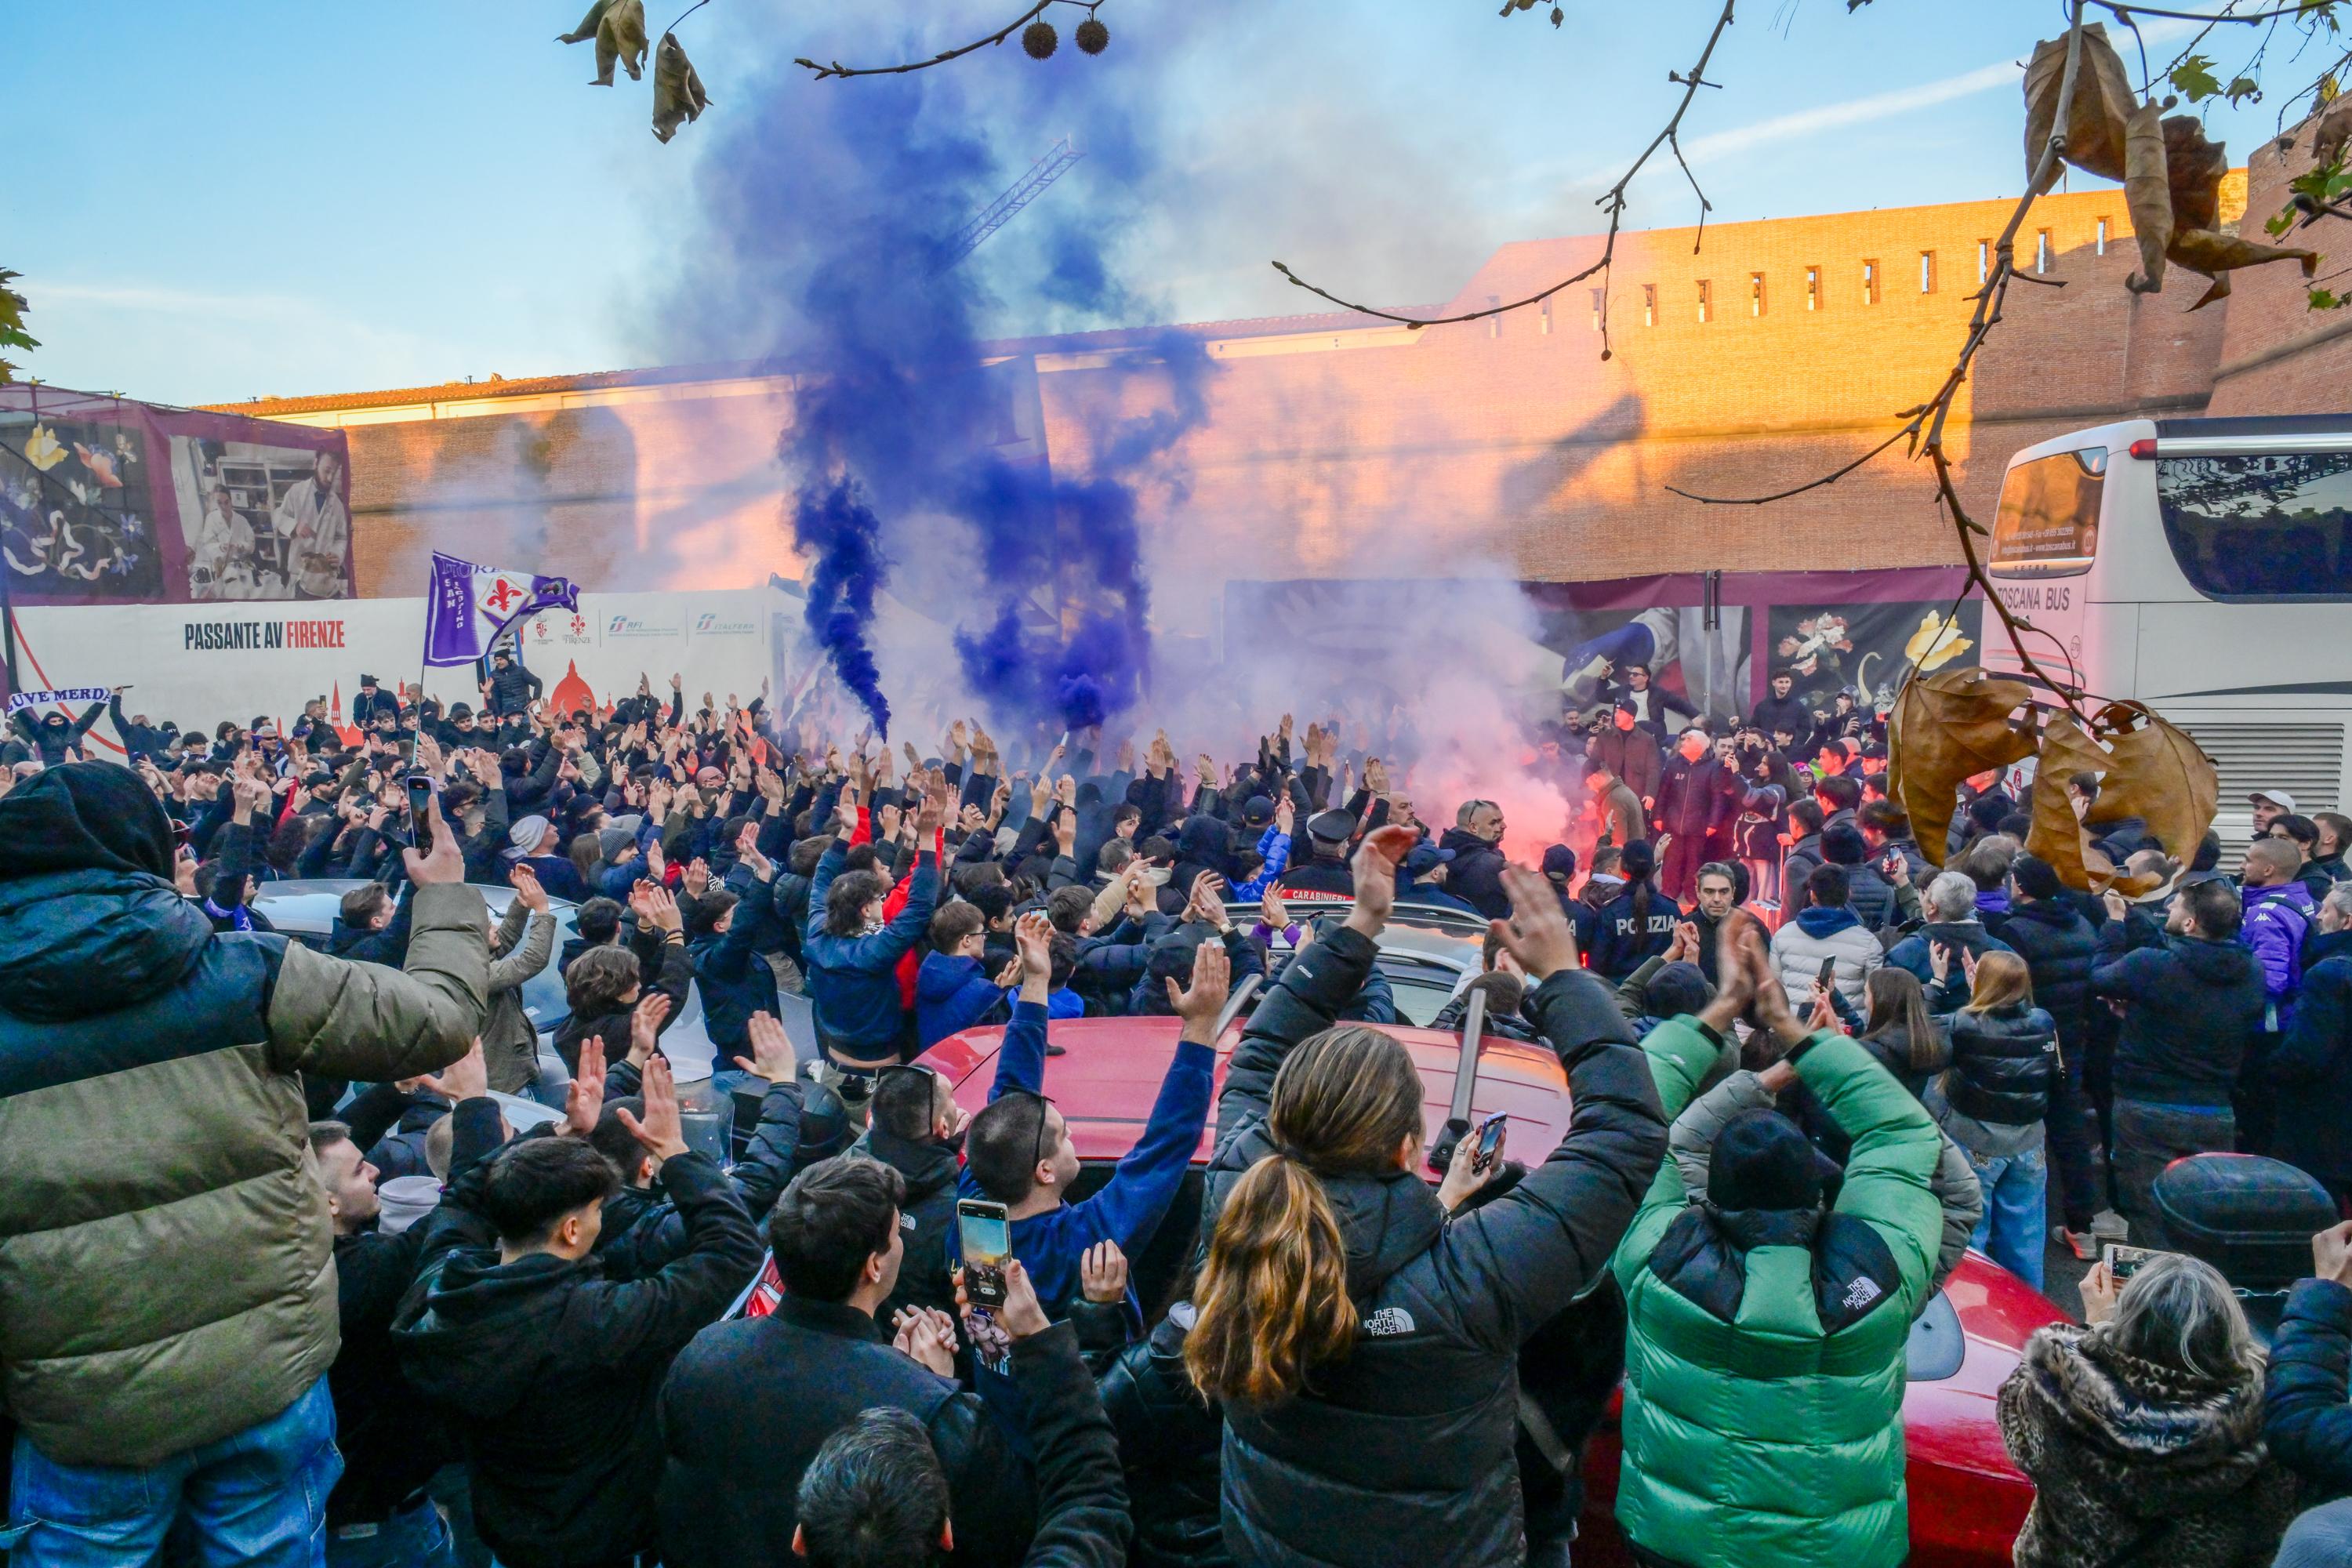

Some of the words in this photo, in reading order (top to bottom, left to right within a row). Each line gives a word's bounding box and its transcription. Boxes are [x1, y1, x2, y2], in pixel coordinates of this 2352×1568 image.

[445, 579, 456, 608] SAN
[1997, 587, 2040, 609] TOSCANA
[2045, 587, 2070, 611] BUS
[184, 622, 261, 650] PASSANTE
[264, 622, 283, 648] AV
[286, 620, 345, 648] FIRENZE
[1293, 891, 1346, 901] CARABINIERI
[1847, 1279, 1861, 1292] THE
[1842, 1287, 1867, 1308] NORTH
[1853, 1293, 1871, 1309] FACE
[1374, 1308, 1393, 1319] THE
[1363, 1317, 1395, 1329] NORTH
[1371, 1326, 1396, 1336] FACE
